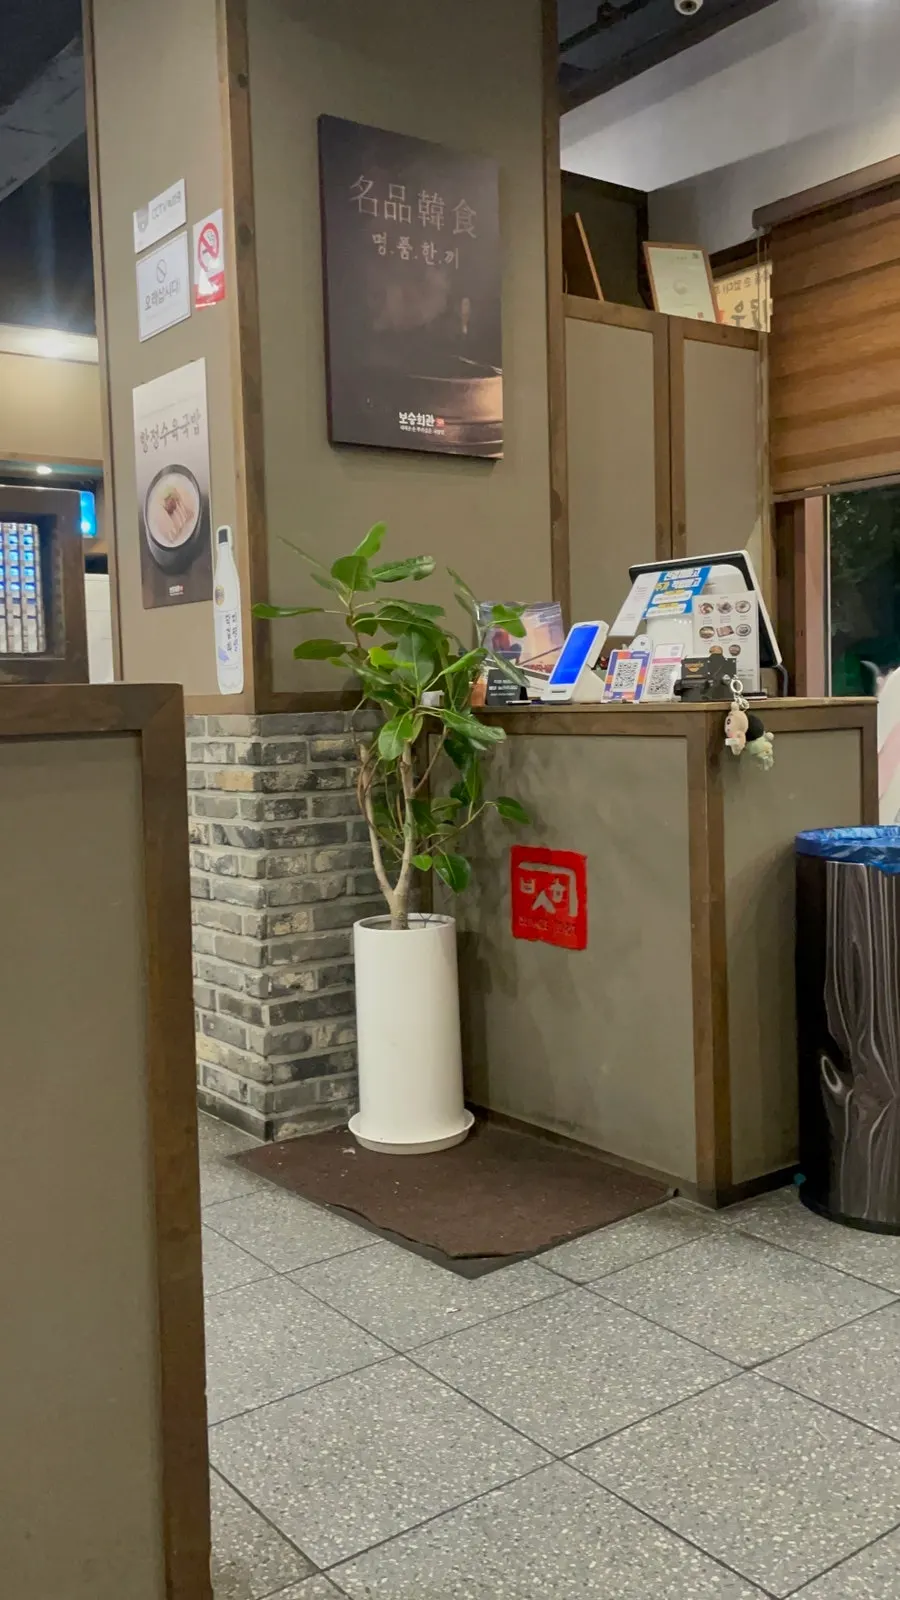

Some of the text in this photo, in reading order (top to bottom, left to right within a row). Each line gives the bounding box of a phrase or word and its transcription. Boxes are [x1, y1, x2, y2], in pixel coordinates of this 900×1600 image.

[350, 174, 477, 239] 名品韓食
[398, 411, 435, 427] 보승회관
